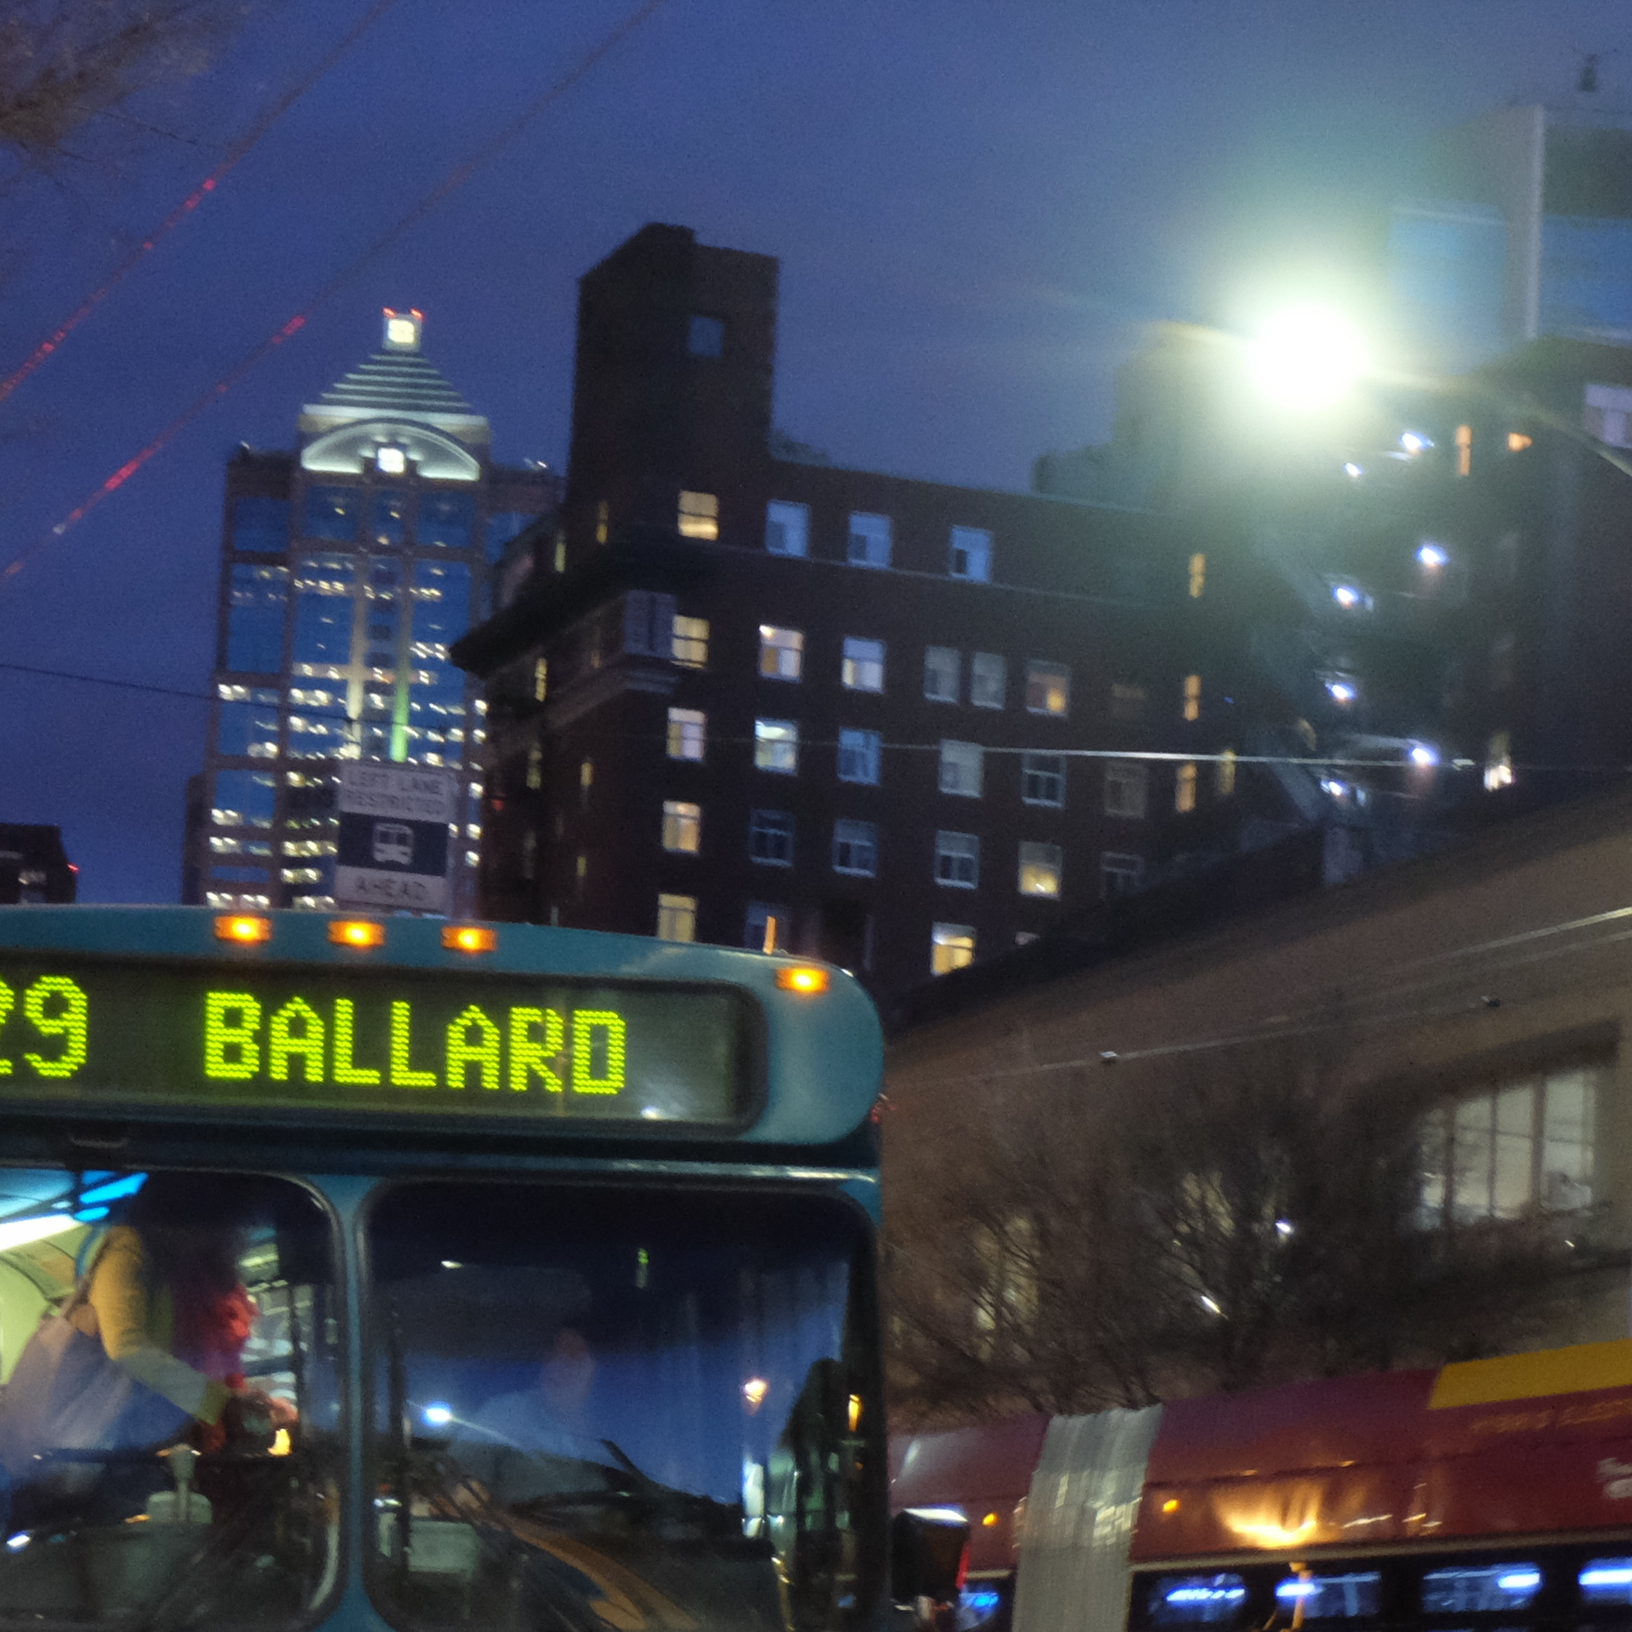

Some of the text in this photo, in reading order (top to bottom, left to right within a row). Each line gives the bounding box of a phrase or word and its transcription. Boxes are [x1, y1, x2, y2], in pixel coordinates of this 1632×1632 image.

[347, 772, 444, 796] LEFT LANE
[355, 874, 429, 901] AHEAD
[204, 991, 626, 1096] BALLARD
